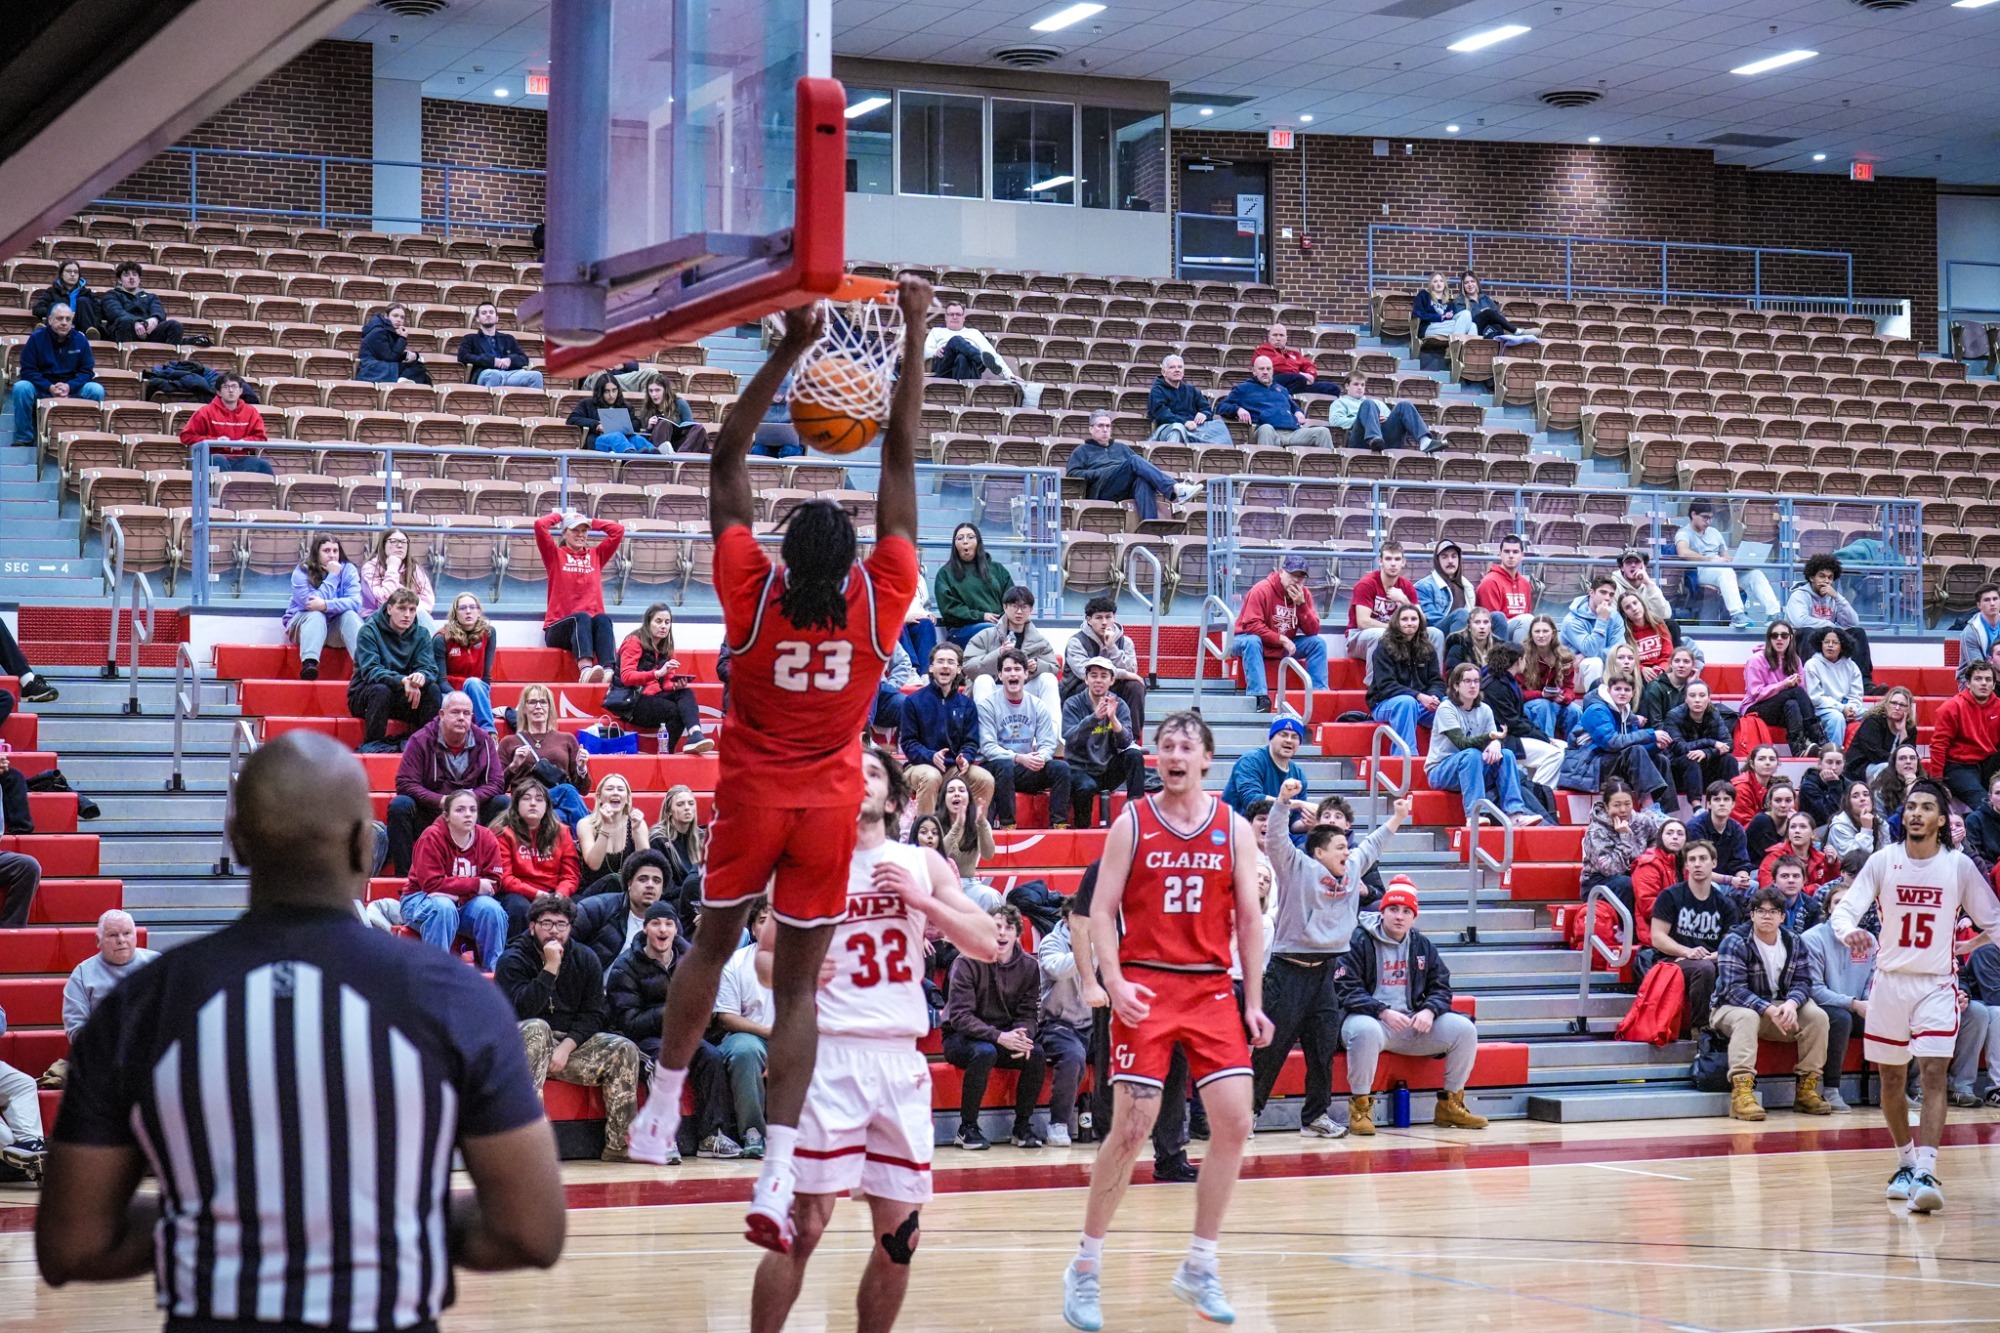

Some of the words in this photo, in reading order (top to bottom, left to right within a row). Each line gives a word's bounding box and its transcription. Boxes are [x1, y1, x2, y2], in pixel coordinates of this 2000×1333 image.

[530, 76, 549, 93] EXIT
[1273, 131, 1292, 147] EXIT
[5, 562, 29, 572] SEC
[61, 563, 69, 573] 4
[774, 640, 853, 692] 23
[1145, 852, 1224, 870] CLARK
[1163, 875, 1204, 913] 22
[1897, 889, 1942, 905] WPI
[1898, 913, 1936, 949] 15
[846, 928, 912, 988] 32
[1116, 1044, 1136, 1069] CU
